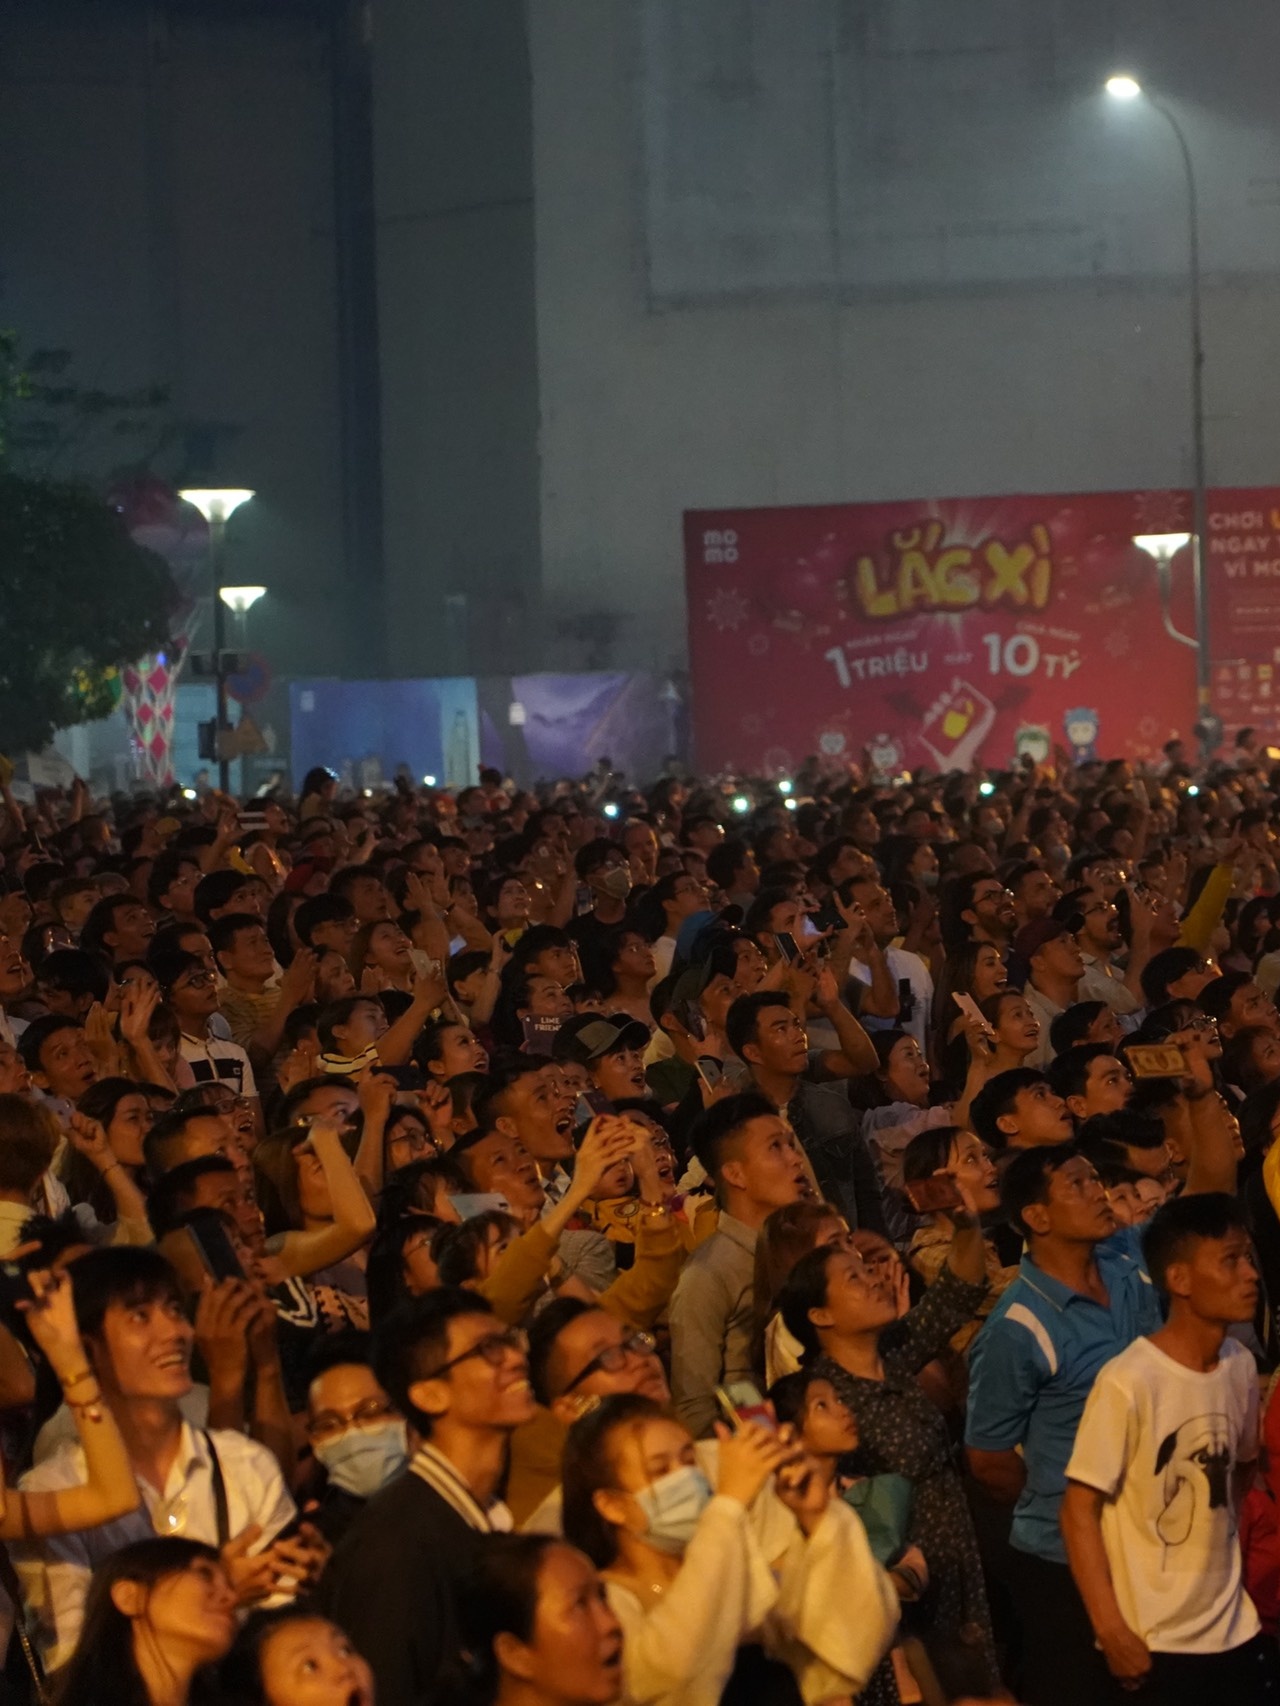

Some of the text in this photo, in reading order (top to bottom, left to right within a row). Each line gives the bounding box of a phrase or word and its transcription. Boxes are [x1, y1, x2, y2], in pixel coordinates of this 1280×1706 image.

[1209, 535, 1271, 554] NGAY
[824, 646, 929, 689] 1 TRIỆU
[982, 632, 1041, 677] 10
